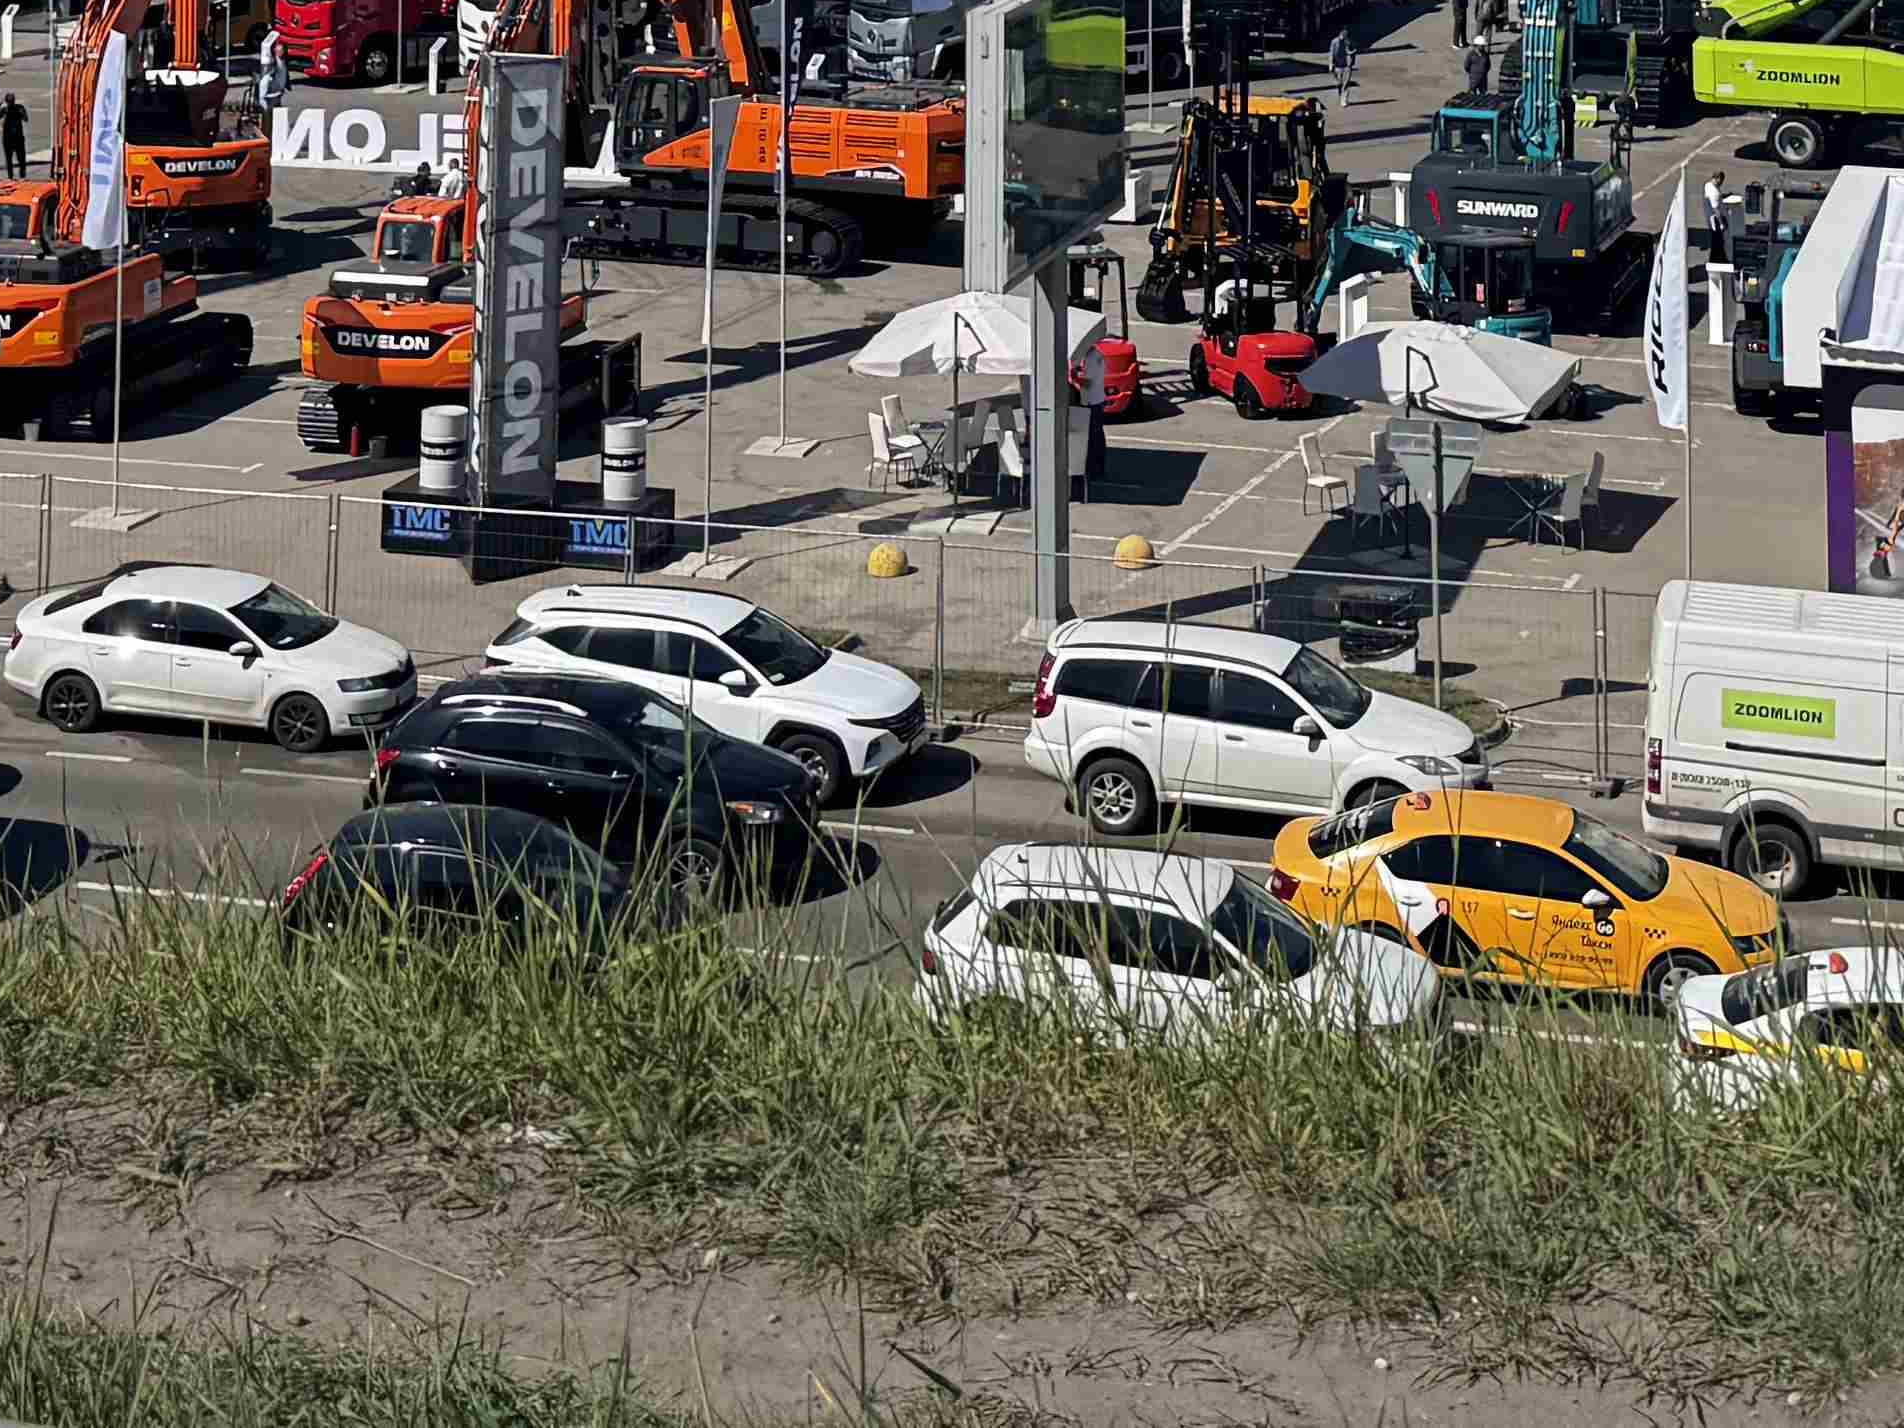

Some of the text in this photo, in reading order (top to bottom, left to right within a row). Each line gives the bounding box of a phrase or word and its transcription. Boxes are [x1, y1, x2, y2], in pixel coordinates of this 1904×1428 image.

[1756, 69, 1841, 86] ZOOMLION
[164, 157, 237, 173] DEVELON
[1457, 199, 1539, 219] SUNWARD
[501, 85, 551, 477] DEVELON
[337, 330, 430, 351] DEVELON
[1734, 702, 1824, 725] ZOOMLION
[1551, 914, 1593, 932] Яндекс
